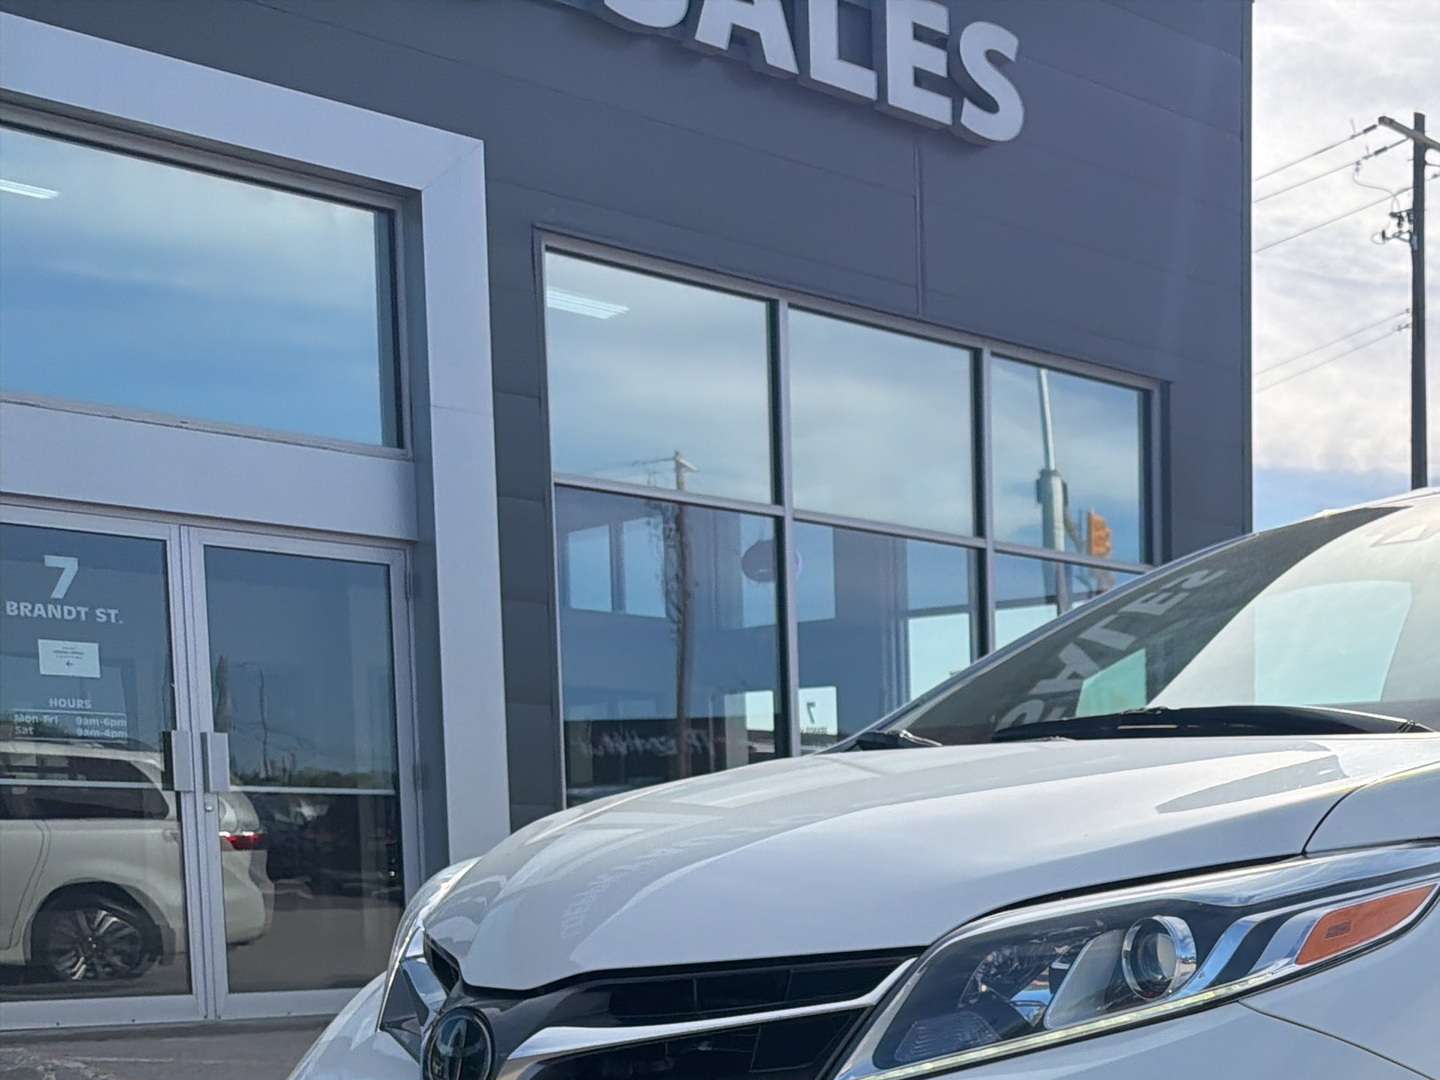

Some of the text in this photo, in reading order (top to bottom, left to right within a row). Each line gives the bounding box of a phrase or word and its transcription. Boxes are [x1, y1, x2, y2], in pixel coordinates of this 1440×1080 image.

[602, 0, 1025, 142] ALES
[44, 555, 79, 599] 7
[6, 600, 123, 624] BRANDT ST.
[50, 698, 92, 709] HOURS
[15, 725, 34, 735] Sat
